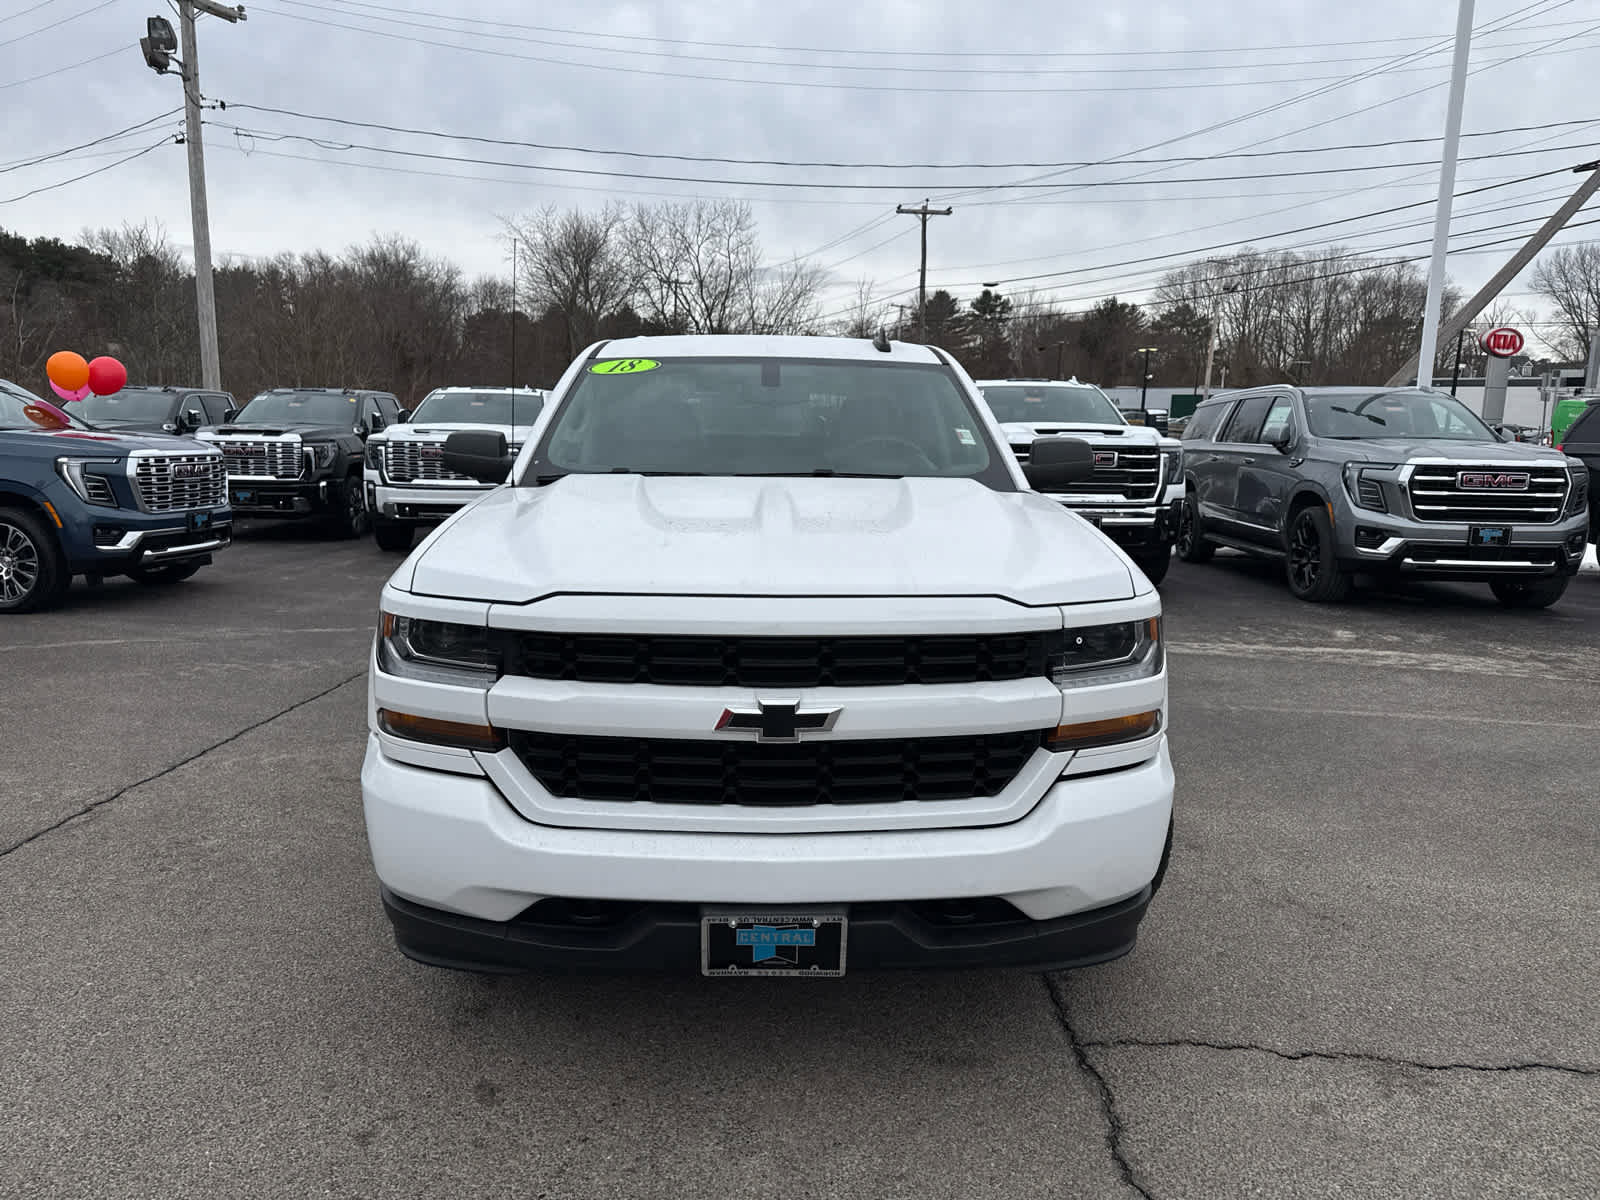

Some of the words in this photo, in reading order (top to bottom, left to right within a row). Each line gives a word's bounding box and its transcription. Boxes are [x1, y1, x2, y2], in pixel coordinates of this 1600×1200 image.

[1492, 333, 1517, 350] KIA
[608, 360, 642, 372] 18
[1463, 474, 1529, 487] GMC
[740, 932, 811, 943] CENTRAL
